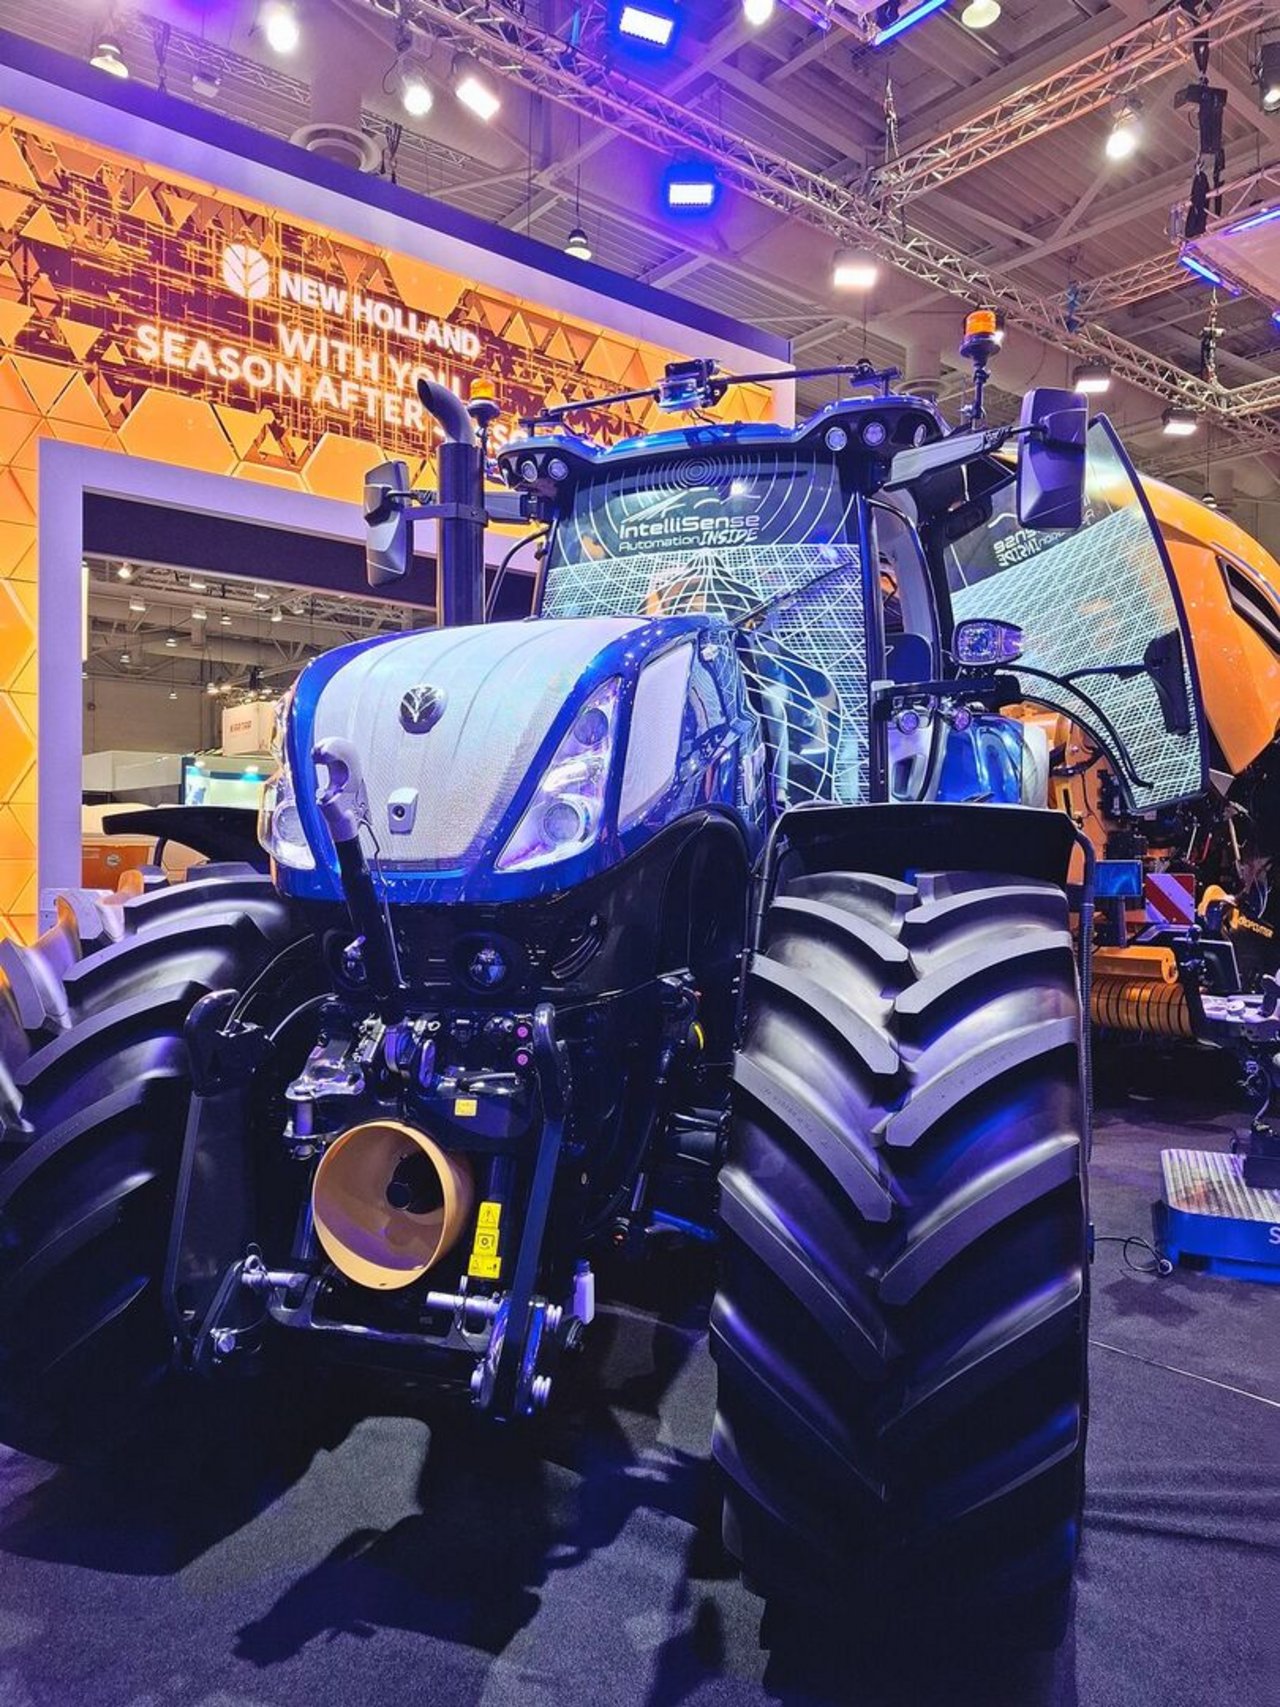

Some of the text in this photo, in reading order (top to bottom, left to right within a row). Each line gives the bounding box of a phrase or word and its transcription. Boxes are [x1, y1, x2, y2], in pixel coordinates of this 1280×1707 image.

[278, 270, 481, 359] NEW HOLLAND
[279, 325, 380, 377] WITH
[136, 325, 301, 394] SEASON
[312, 375, 425, 430] AFTER
[618, 528, 758, 553] Automation INSIDE
[619, 514, 760, 540] IntelliSense
